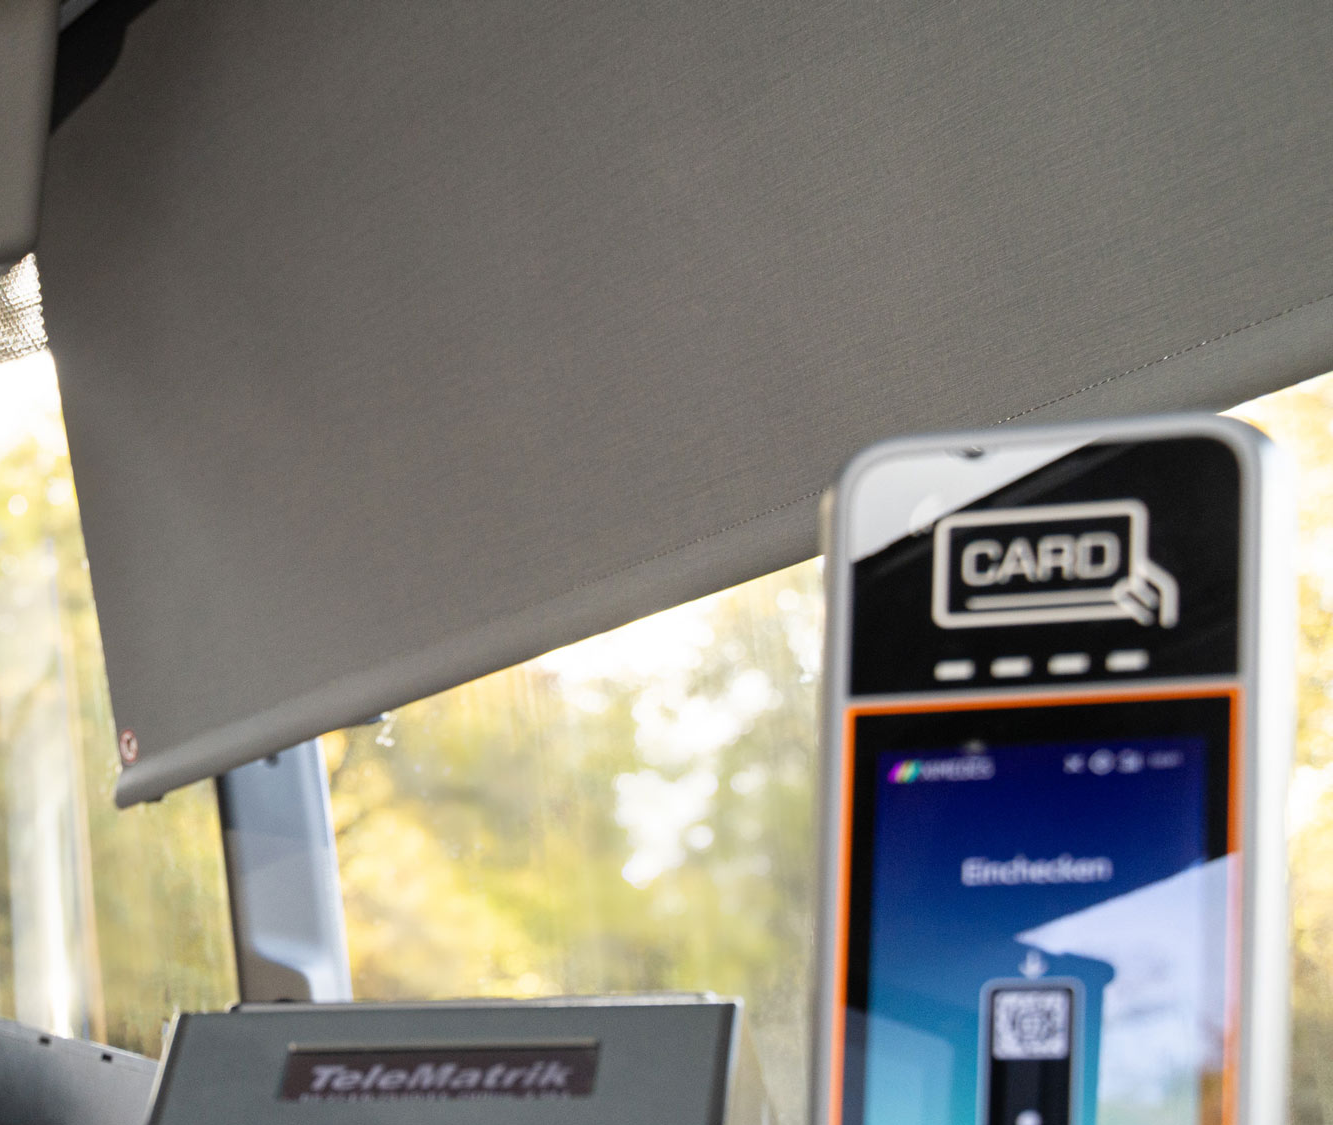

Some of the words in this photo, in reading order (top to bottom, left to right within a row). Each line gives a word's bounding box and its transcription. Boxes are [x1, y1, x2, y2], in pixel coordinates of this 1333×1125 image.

[961, 531, 1121, 587] CARD
[961, 853, 1114, 886] Einchecken
[309, 1060, 573, 1092] TeleMatrik
